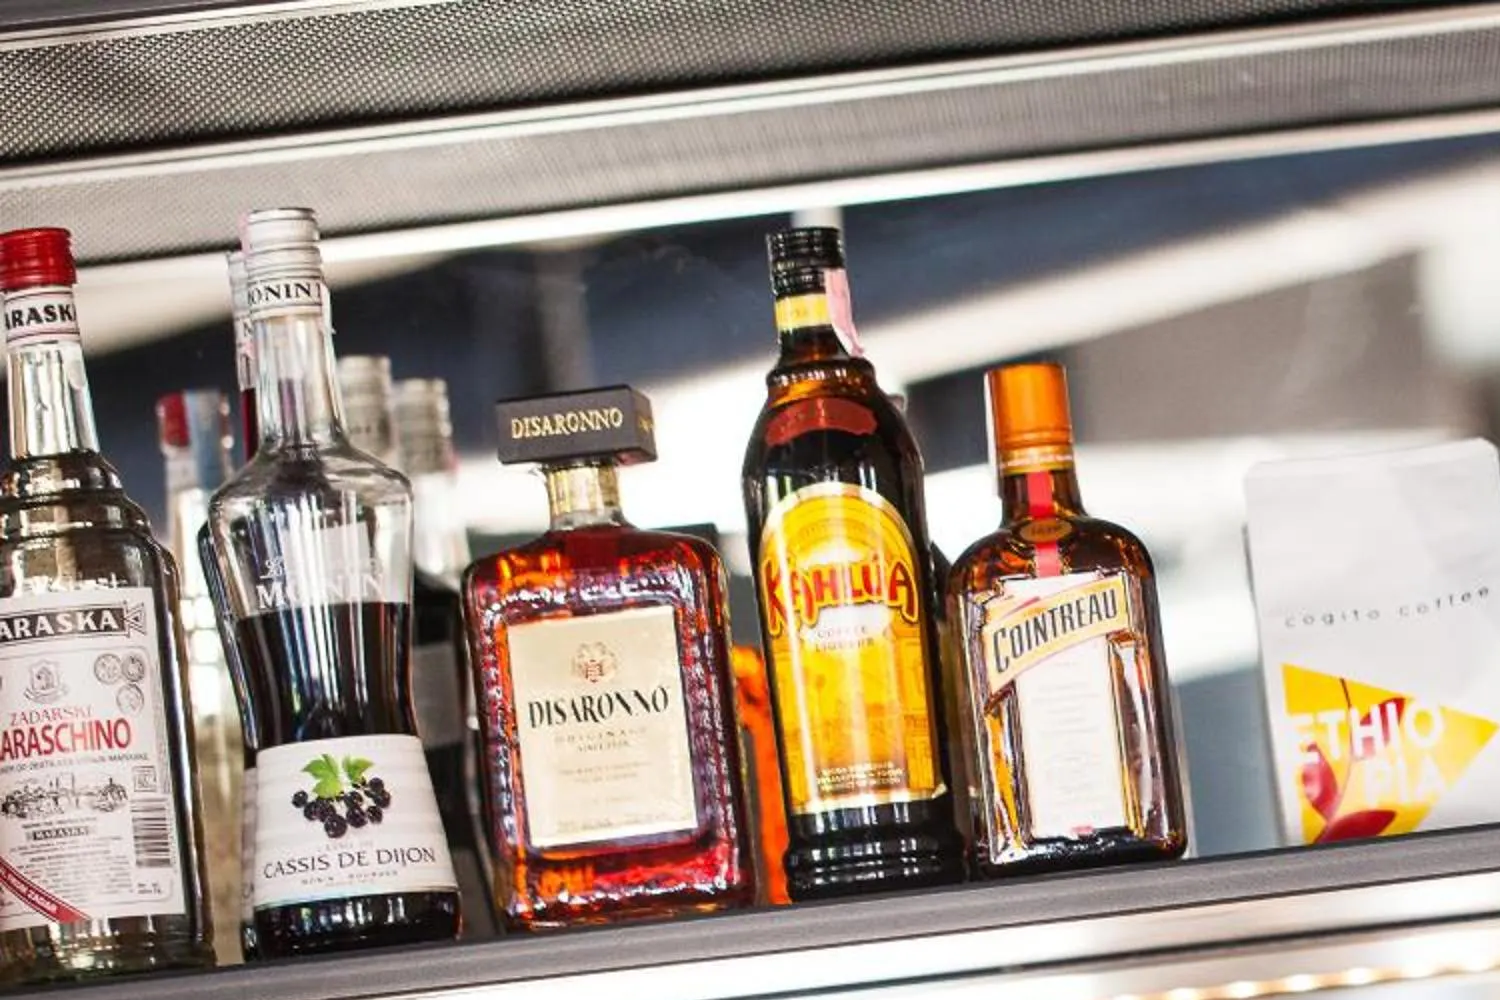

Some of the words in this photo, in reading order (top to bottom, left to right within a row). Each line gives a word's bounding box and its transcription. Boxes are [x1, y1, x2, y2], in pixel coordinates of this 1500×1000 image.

[511, 407, 624, 440] DISARONNO
[1285, 608, 1380, 628] cogito
[1399, 586, 1489, 616] coffee
[992, 588, 1118, 676] COINTREAU
[528, 685, 670, 729] DISARONNO
[1290, 699, 1444, 766] ETHIO
[263, 855, 331, 879] CASSIS
[338, 851, 369, 869] DE
[376, 846, 436, 867] DIJON
